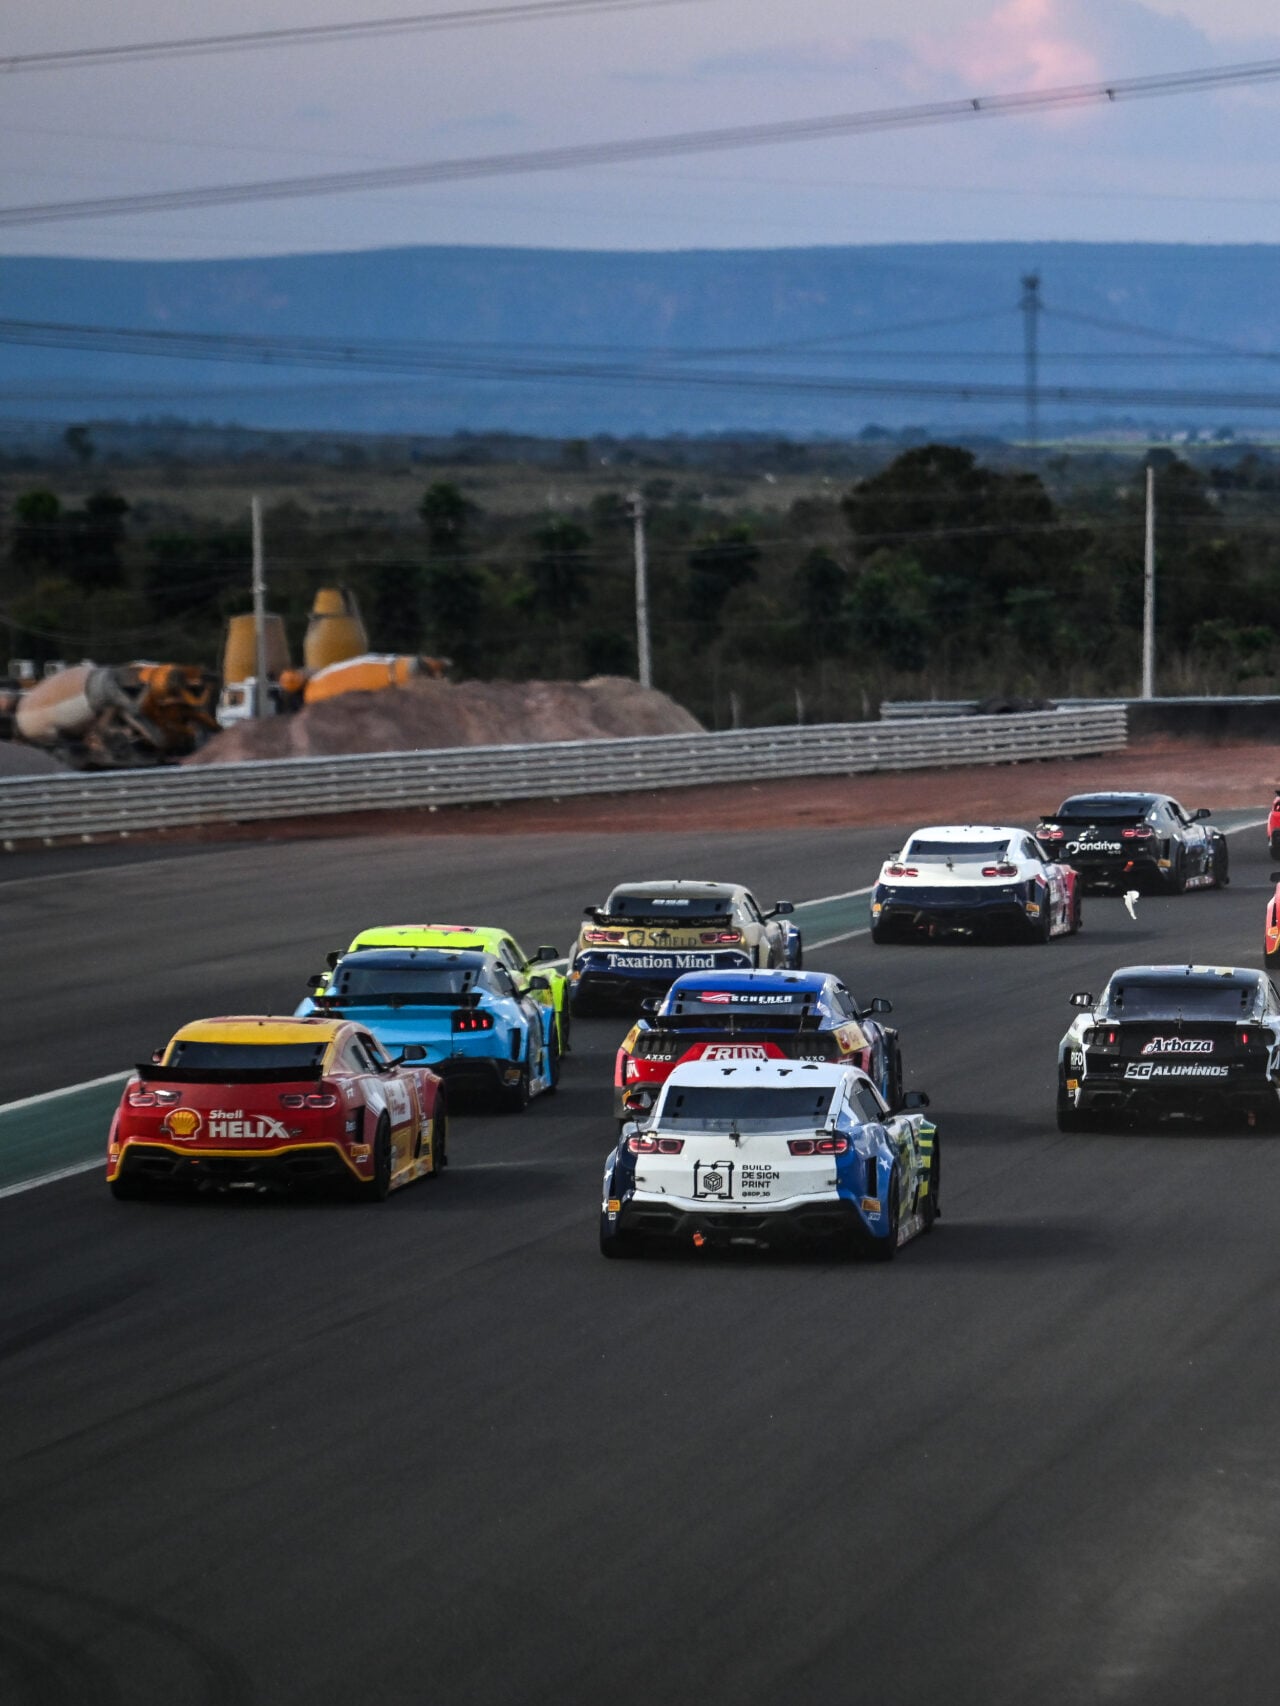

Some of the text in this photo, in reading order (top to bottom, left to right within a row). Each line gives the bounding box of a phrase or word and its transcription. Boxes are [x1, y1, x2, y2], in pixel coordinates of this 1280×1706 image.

[607, 953, 715, 969] Taxation Mind
[1141, 1037, 1213, 1055] Arbaza
[1125, 1063, 1153, 1079] SG
[208, 1110, 243, 1119] Shell
[208, 1114, 290, 1139] HELIX
[742, 1181, 771, 1189] PRINT
